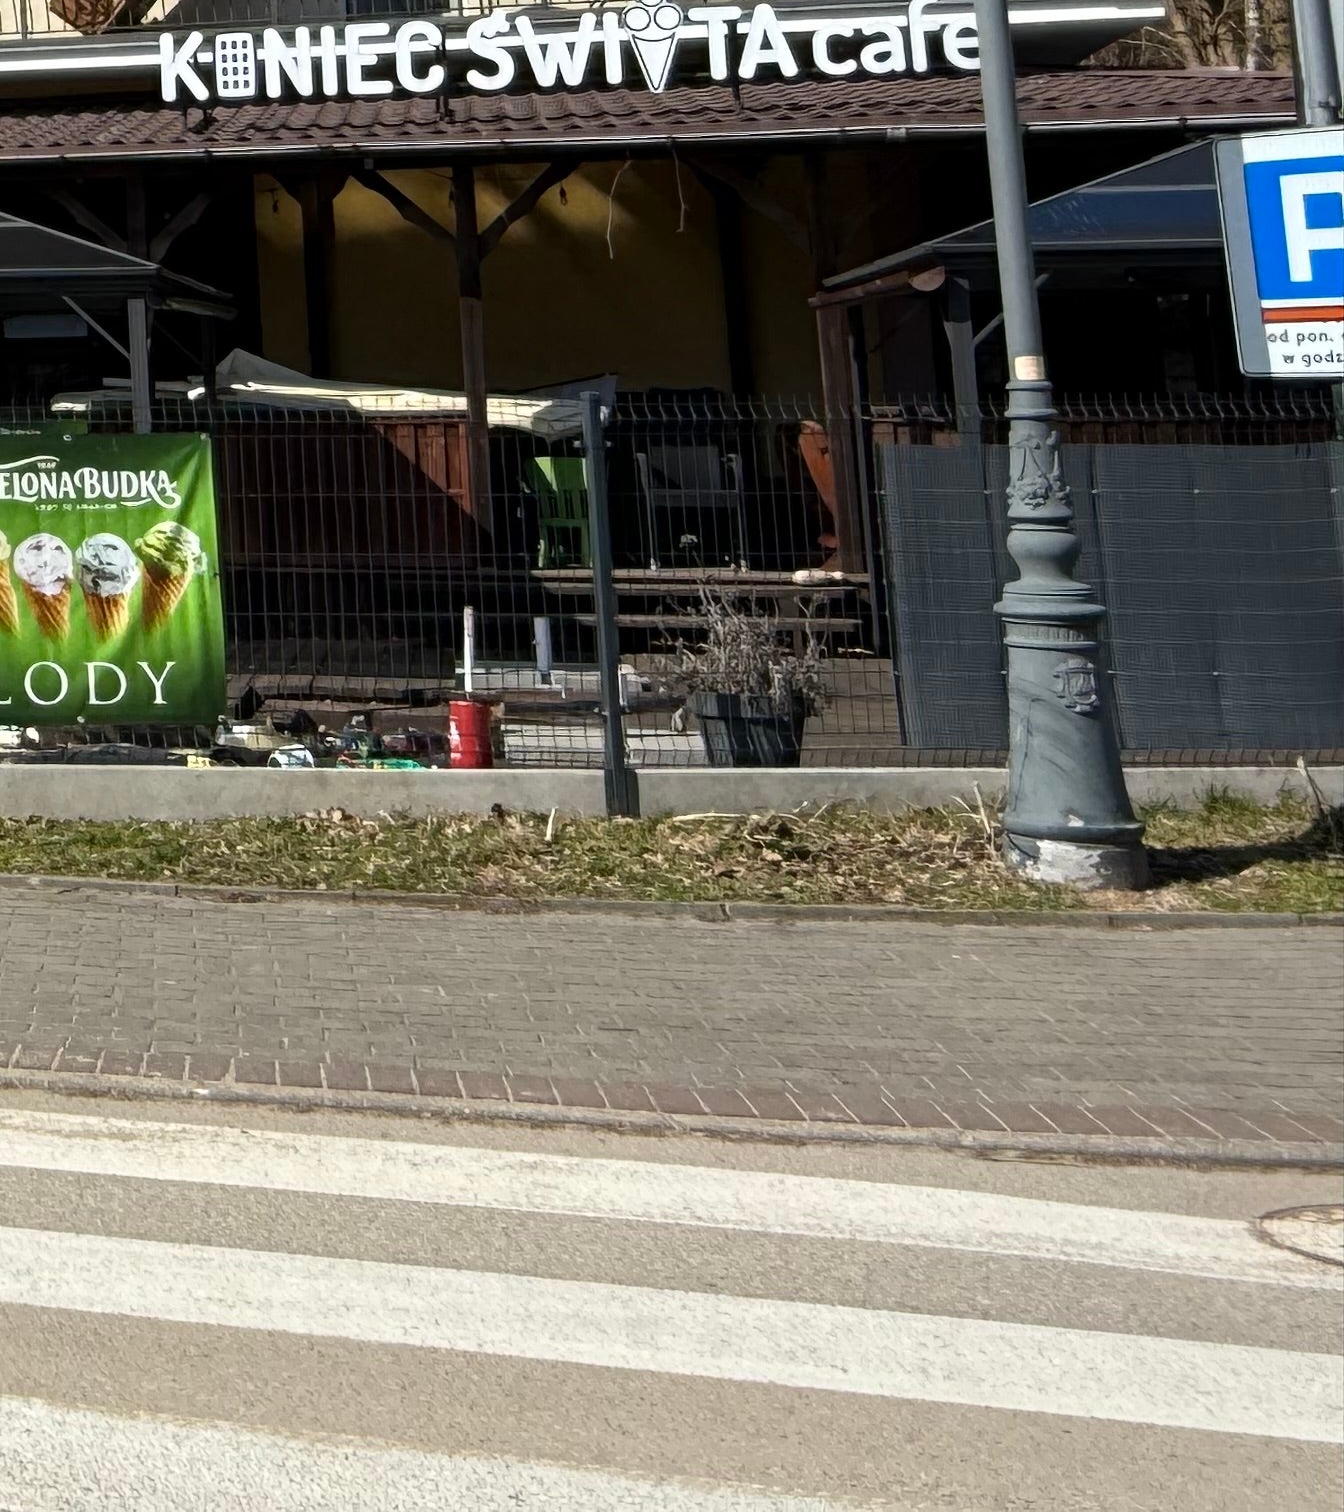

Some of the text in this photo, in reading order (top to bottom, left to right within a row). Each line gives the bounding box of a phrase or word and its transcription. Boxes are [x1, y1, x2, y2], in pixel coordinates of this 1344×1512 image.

[1267, 329, 1289, 343] od
[1296, 332, 1334, 347] pon.
[1281, 354, 1295, 365] w
